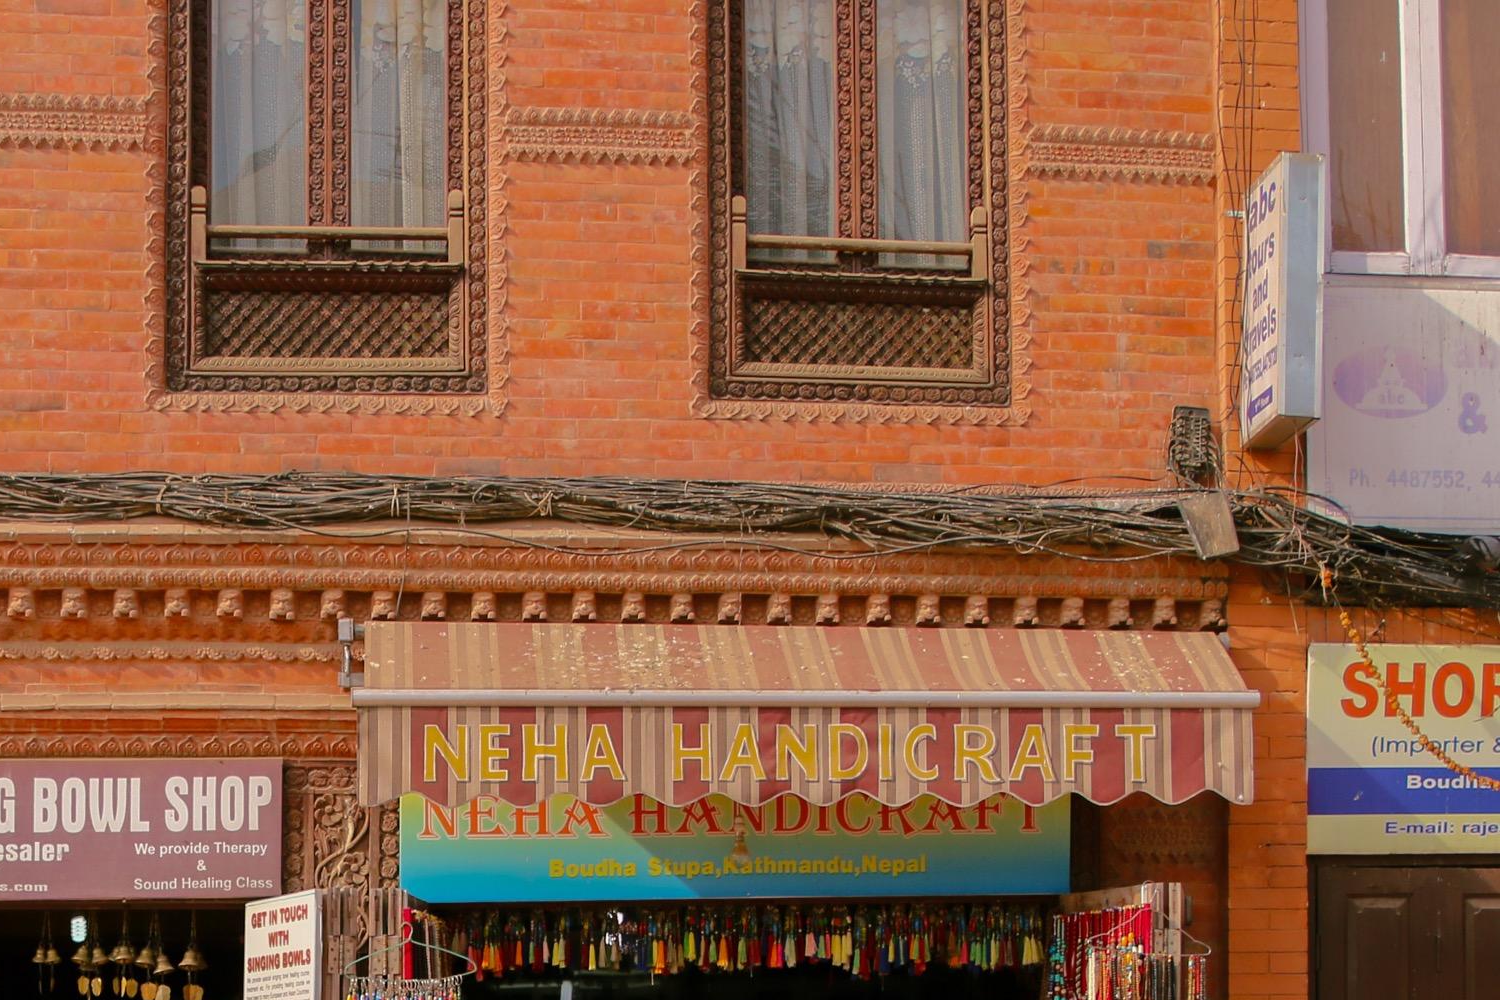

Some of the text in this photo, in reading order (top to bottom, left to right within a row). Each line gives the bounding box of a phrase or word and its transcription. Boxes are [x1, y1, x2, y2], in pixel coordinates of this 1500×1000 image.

[1249, 182, 1276, 233] abc
[1252, 268, 1268, 312] and
[1349, 467, 1377, 488] Ph.
[423, 723, 1156, 783] NEHA HANDICRAFT
[33, 777, 150, 833] BOWL
[164, 776, 273, 833] SHOP
[417, 794, 611, 840] NEHA
[1385, 821, 1455, 834] E-mail:
[134, 841, 268, 858] We provide Therapy
[196, 859, 207, 872] &
[548, 857, 637, 878] Boudha
[133, 876, 274, 891] Sound Healing Class
[251, 904, 308, 929] GET IN TOUCH
[268, 930, 289, 948] WITH
[247, 948, 311, 973] SINGING BOWLS
